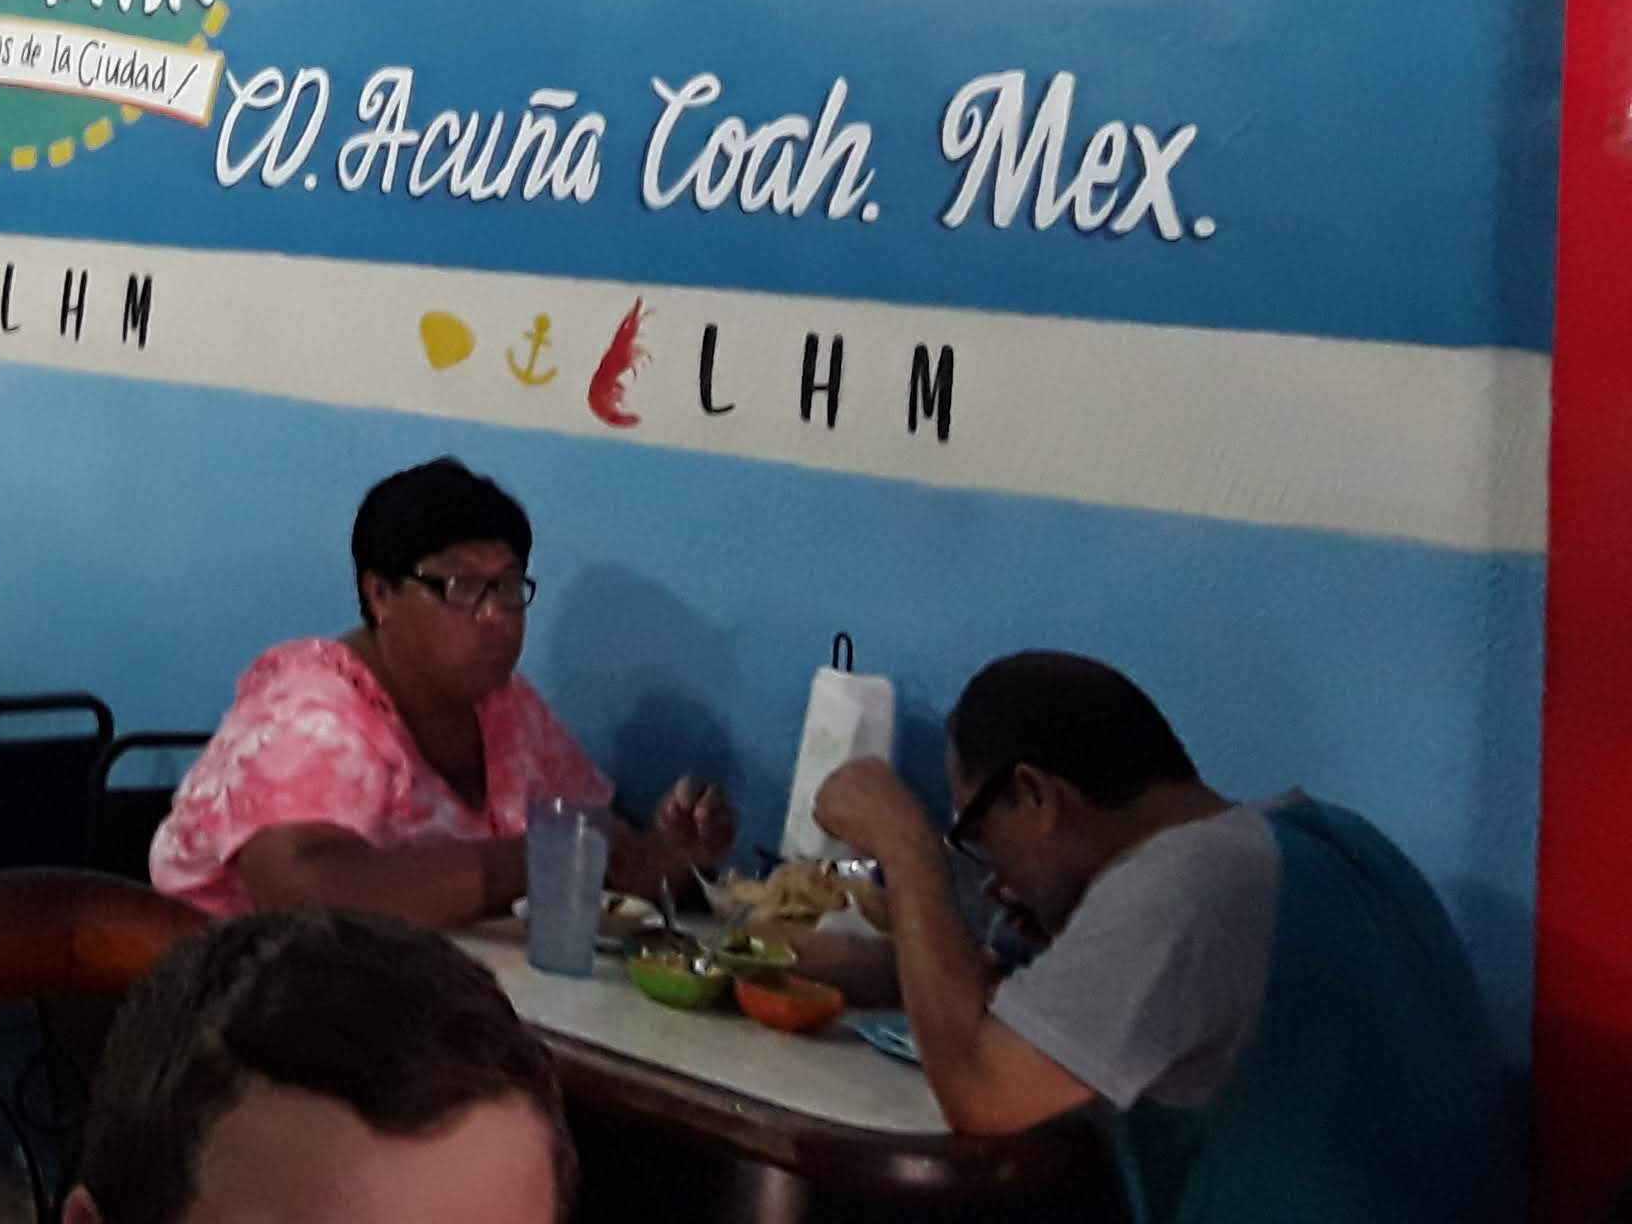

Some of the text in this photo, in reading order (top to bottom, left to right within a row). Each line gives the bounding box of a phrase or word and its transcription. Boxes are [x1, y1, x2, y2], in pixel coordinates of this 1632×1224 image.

[20, 33, 42, 68] de
[50, 34, 72, 74] la
[338, 64, 609, 204] Acuña
[642, 71, 881, 223] Coah.
[940, 68, 1218, 242] Mex.
